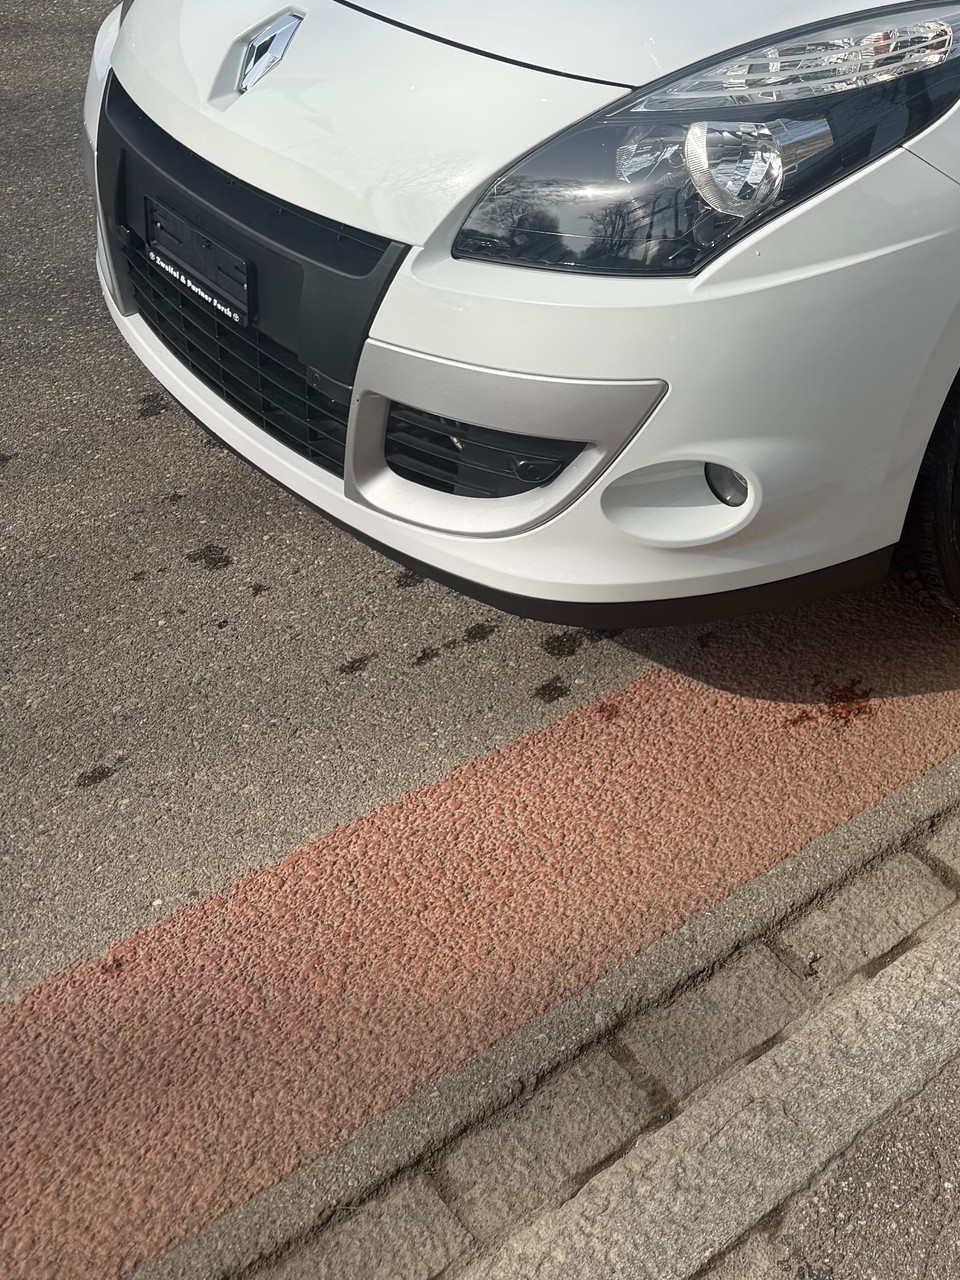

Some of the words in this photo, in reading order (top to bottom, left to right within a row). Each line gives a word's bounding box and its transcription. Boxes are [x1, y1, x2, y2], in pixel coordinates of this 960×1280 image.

[156, 255, 180, 279] Zweifel
[180, 275, 187, 285] &
[187, 279, 212, 303] Partner
